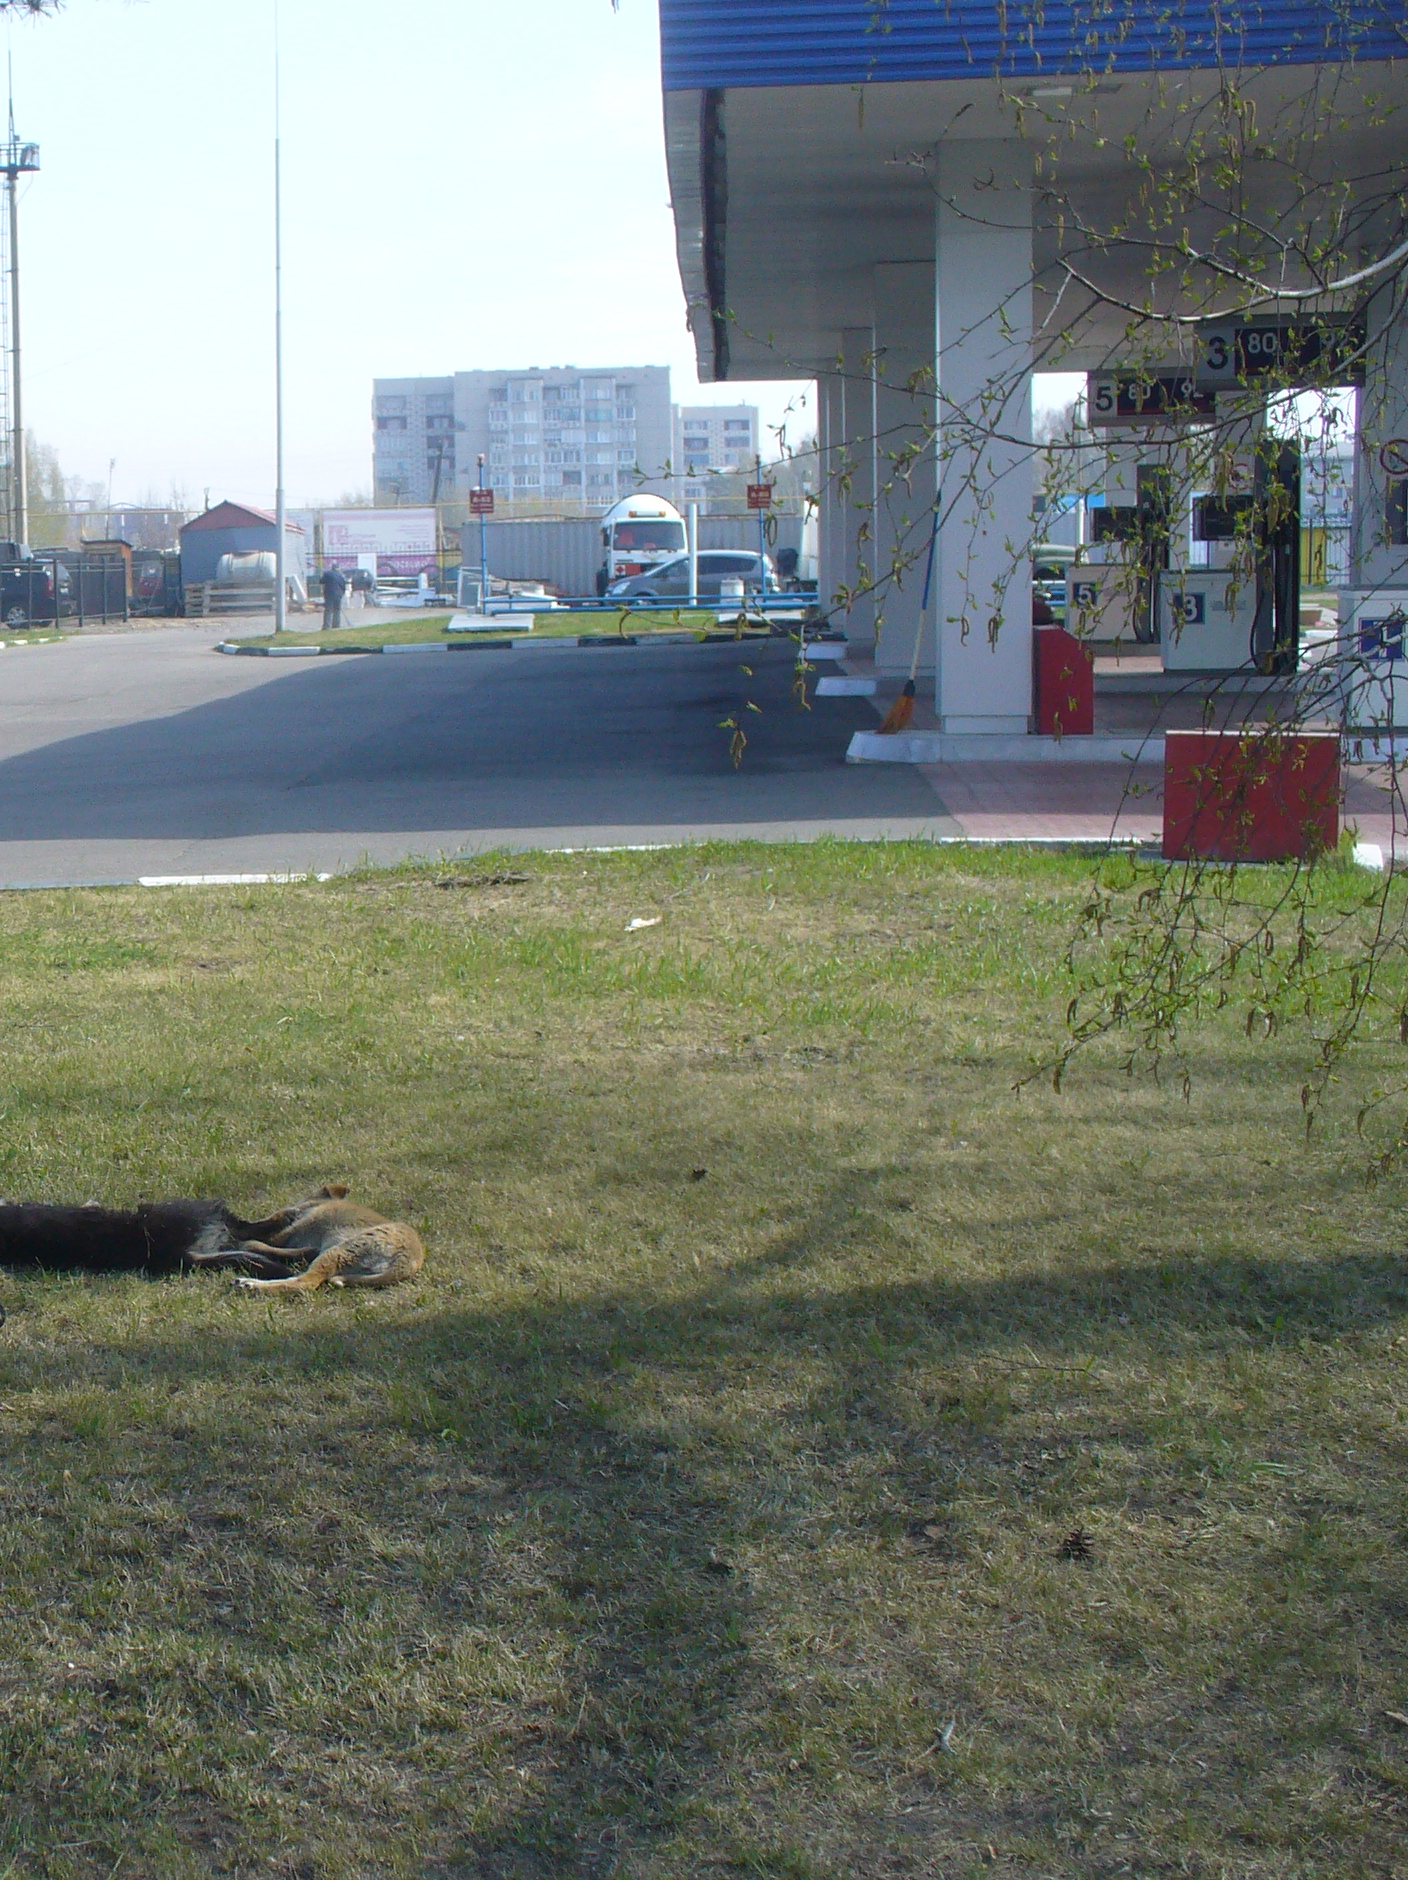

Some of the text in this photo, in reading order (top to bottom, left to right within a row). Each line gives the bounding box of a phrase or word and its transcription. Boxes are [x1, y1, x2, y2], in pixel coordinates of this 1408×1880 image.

[1206, 336, 1229, 370] 3
[1248, 331, 1277, 355] 80
[1095, 386, 1113, 411] 5
[1077, 584, 1092, 606] 5
